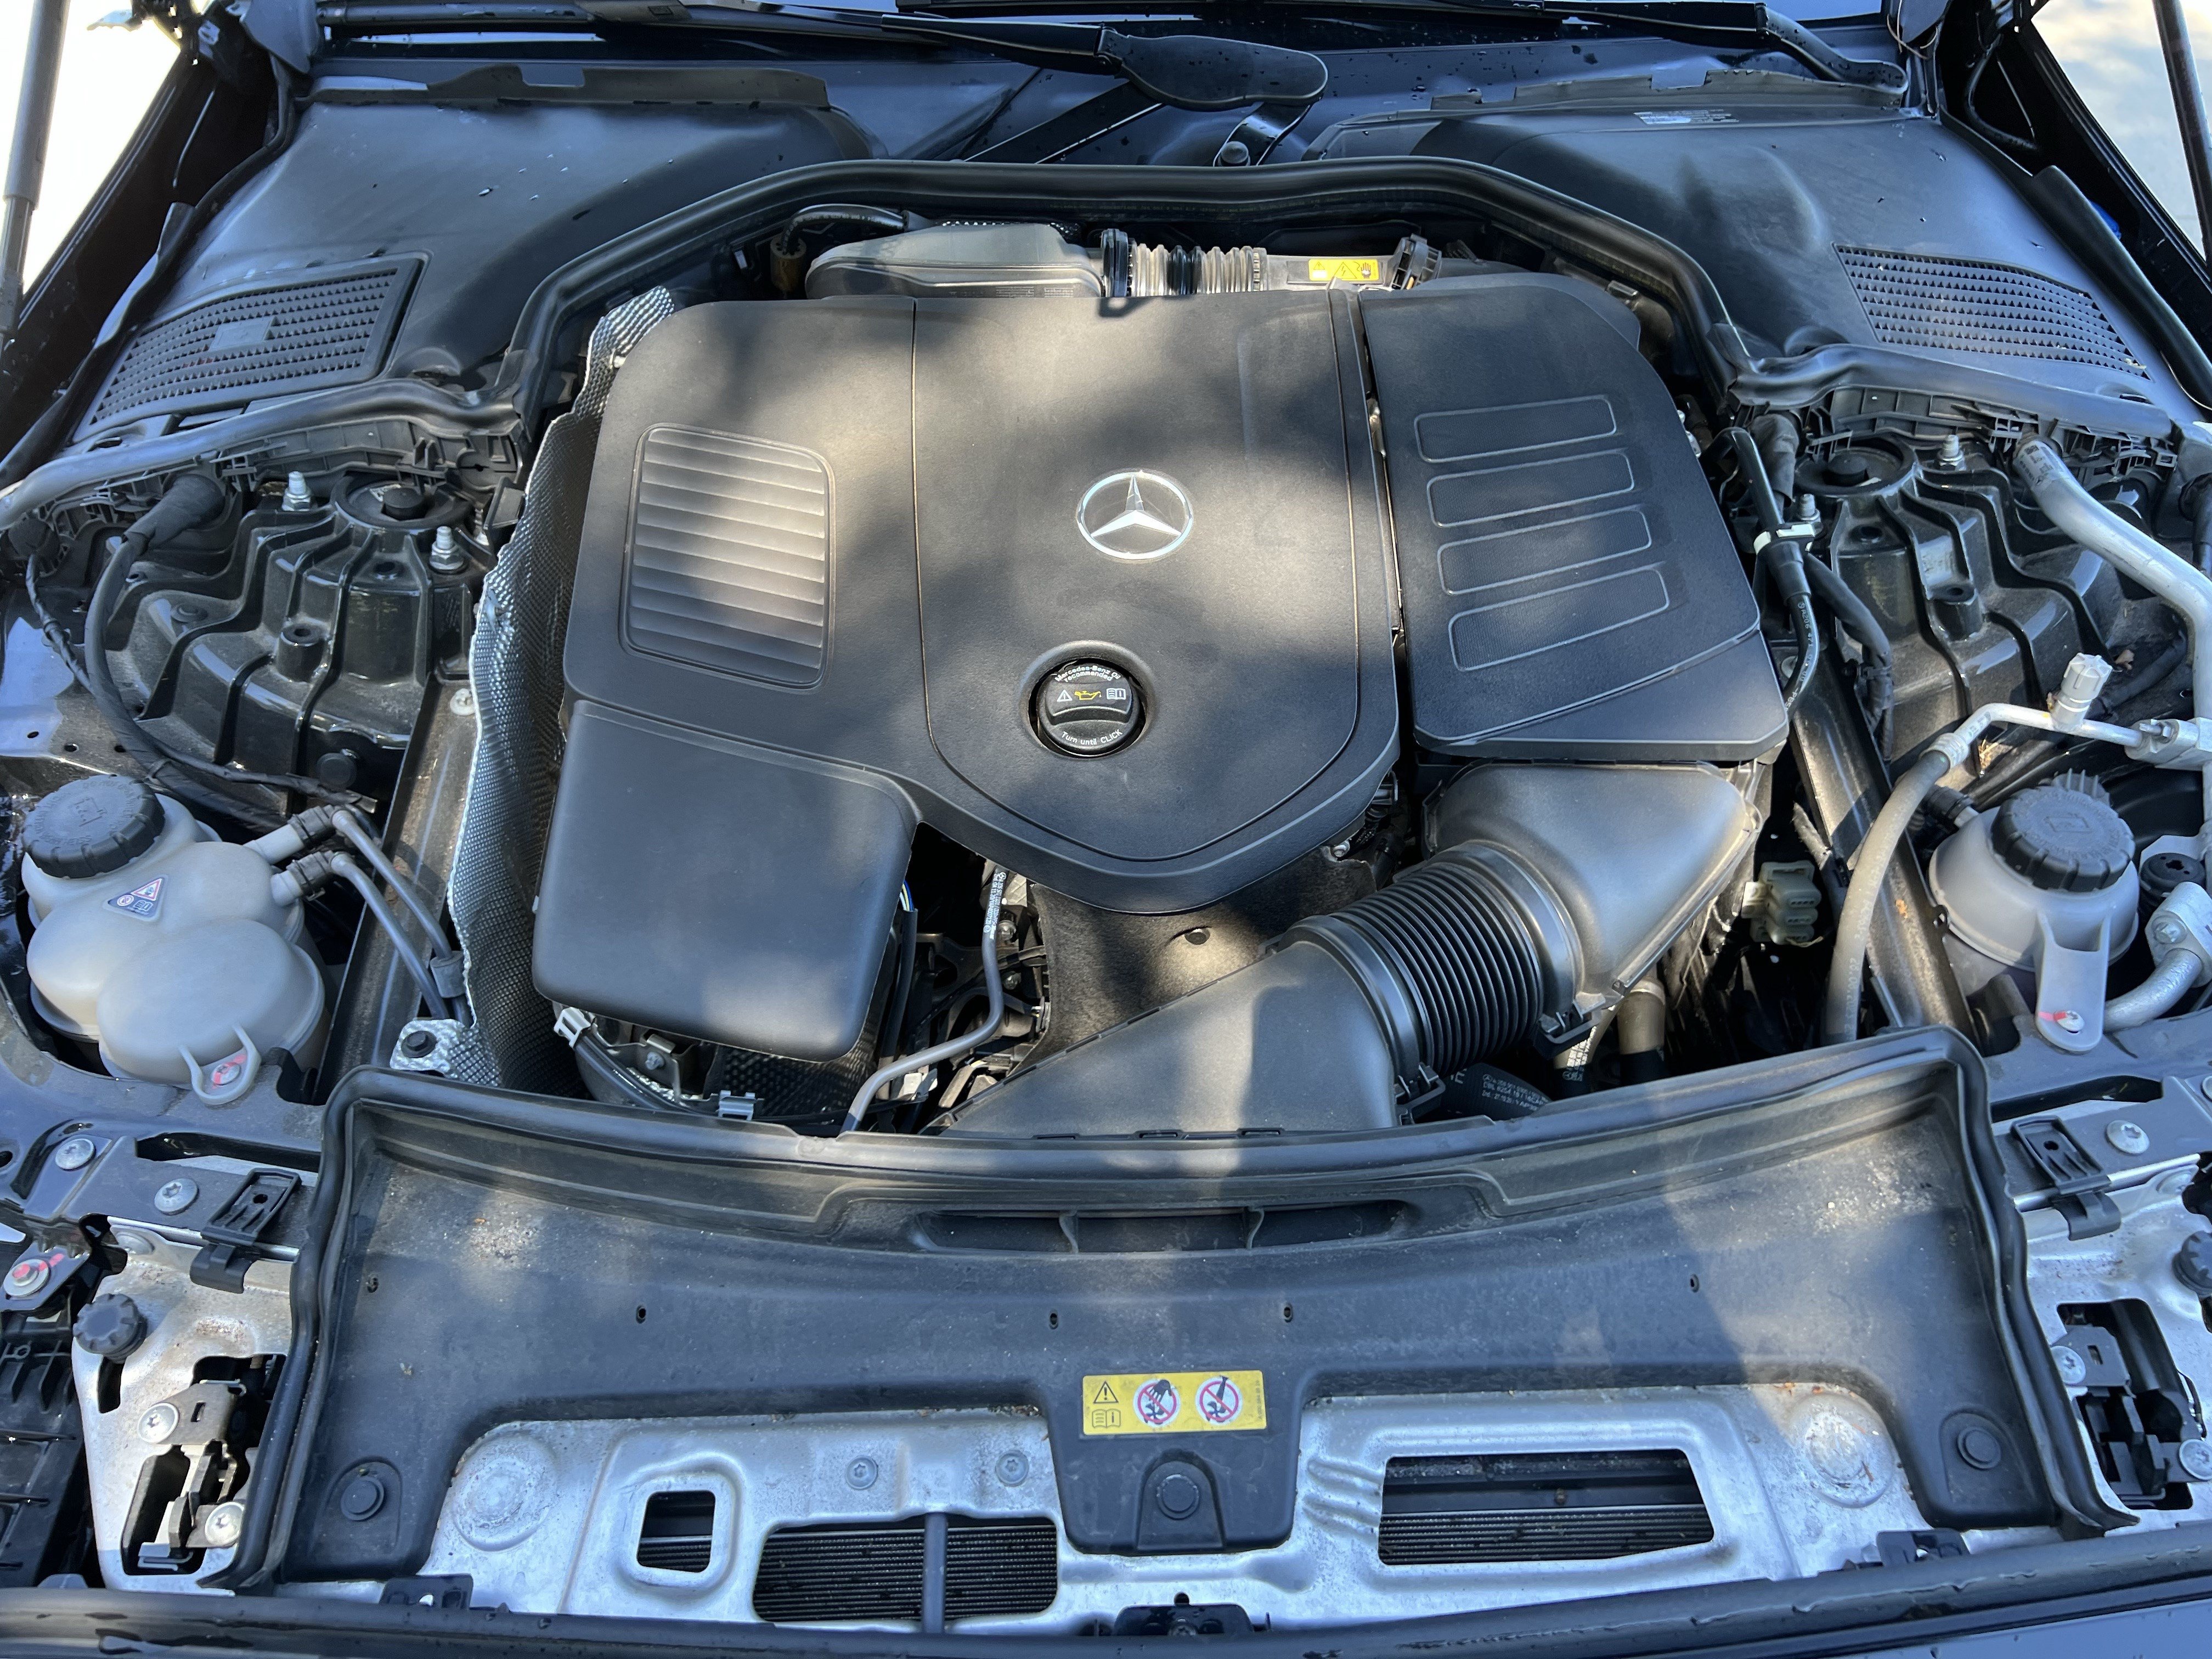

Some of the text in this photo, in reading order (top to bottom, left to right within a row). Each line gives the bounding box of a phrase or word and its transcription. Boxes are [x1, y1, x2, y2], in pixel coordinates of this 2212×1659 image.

[1054, 665, 1121, 682] Mercedes-Benz Oil
[1063, 671, 1113, 682] recommended
[1062, 731, 1078, 743] Turn
[1100, 729, 1123, 743] CLICK
